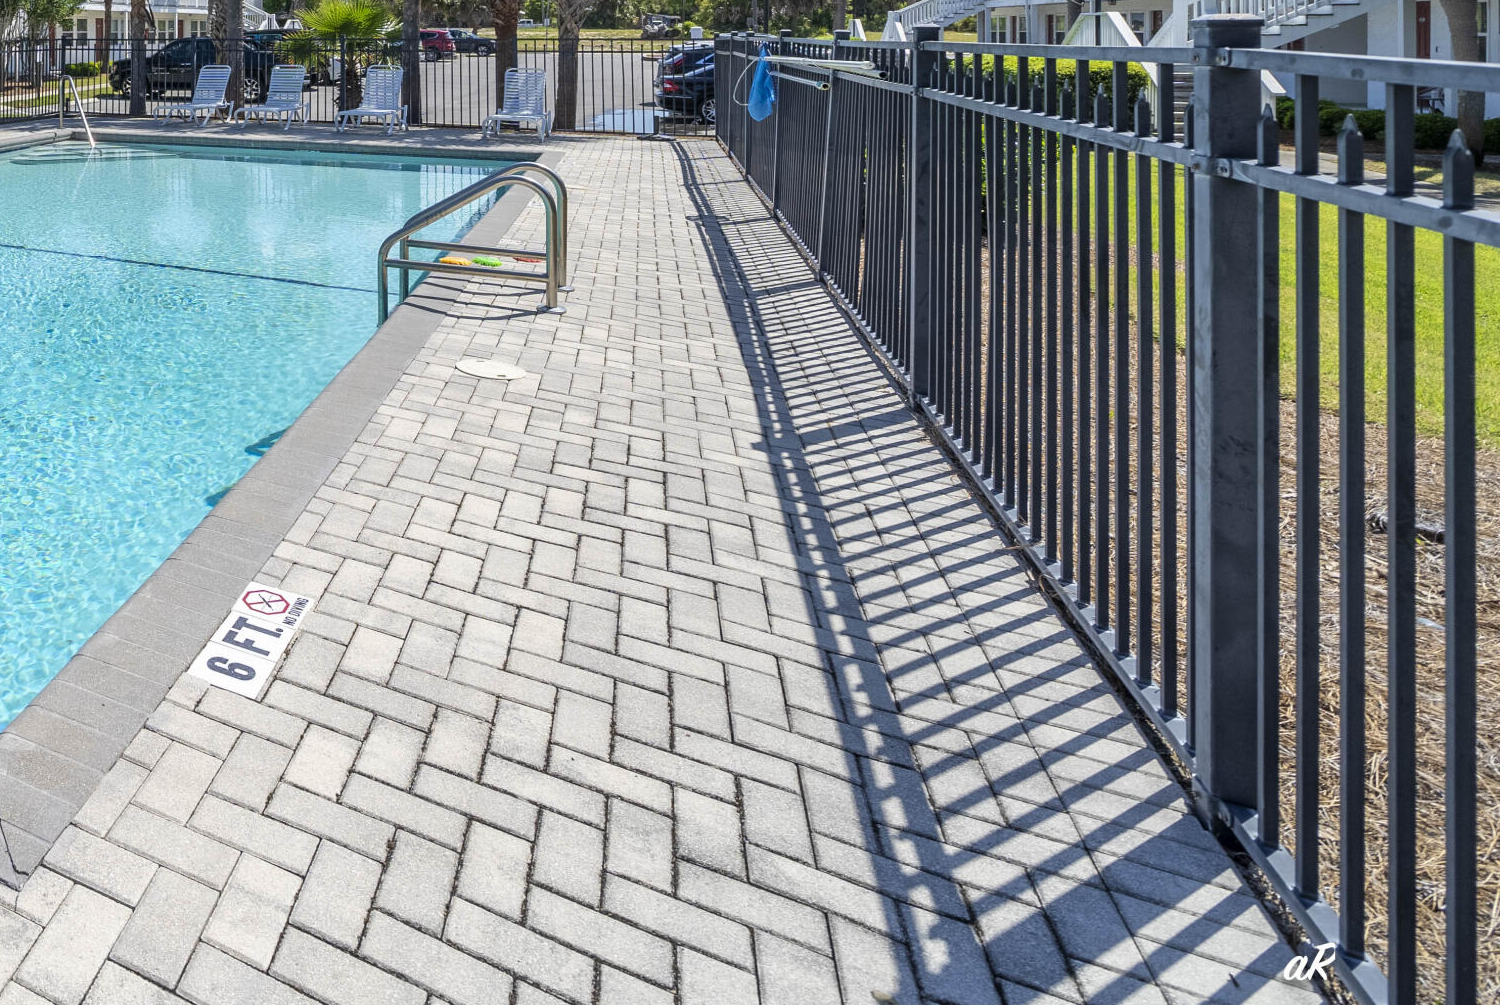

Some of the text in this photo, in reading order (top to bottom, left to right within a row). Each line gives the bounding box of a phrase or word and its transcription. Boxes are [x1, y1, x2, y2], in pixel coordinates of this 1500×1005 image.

[282, 597, 310, 627] NO DIVING
[206, 656, 256, 681] 6
